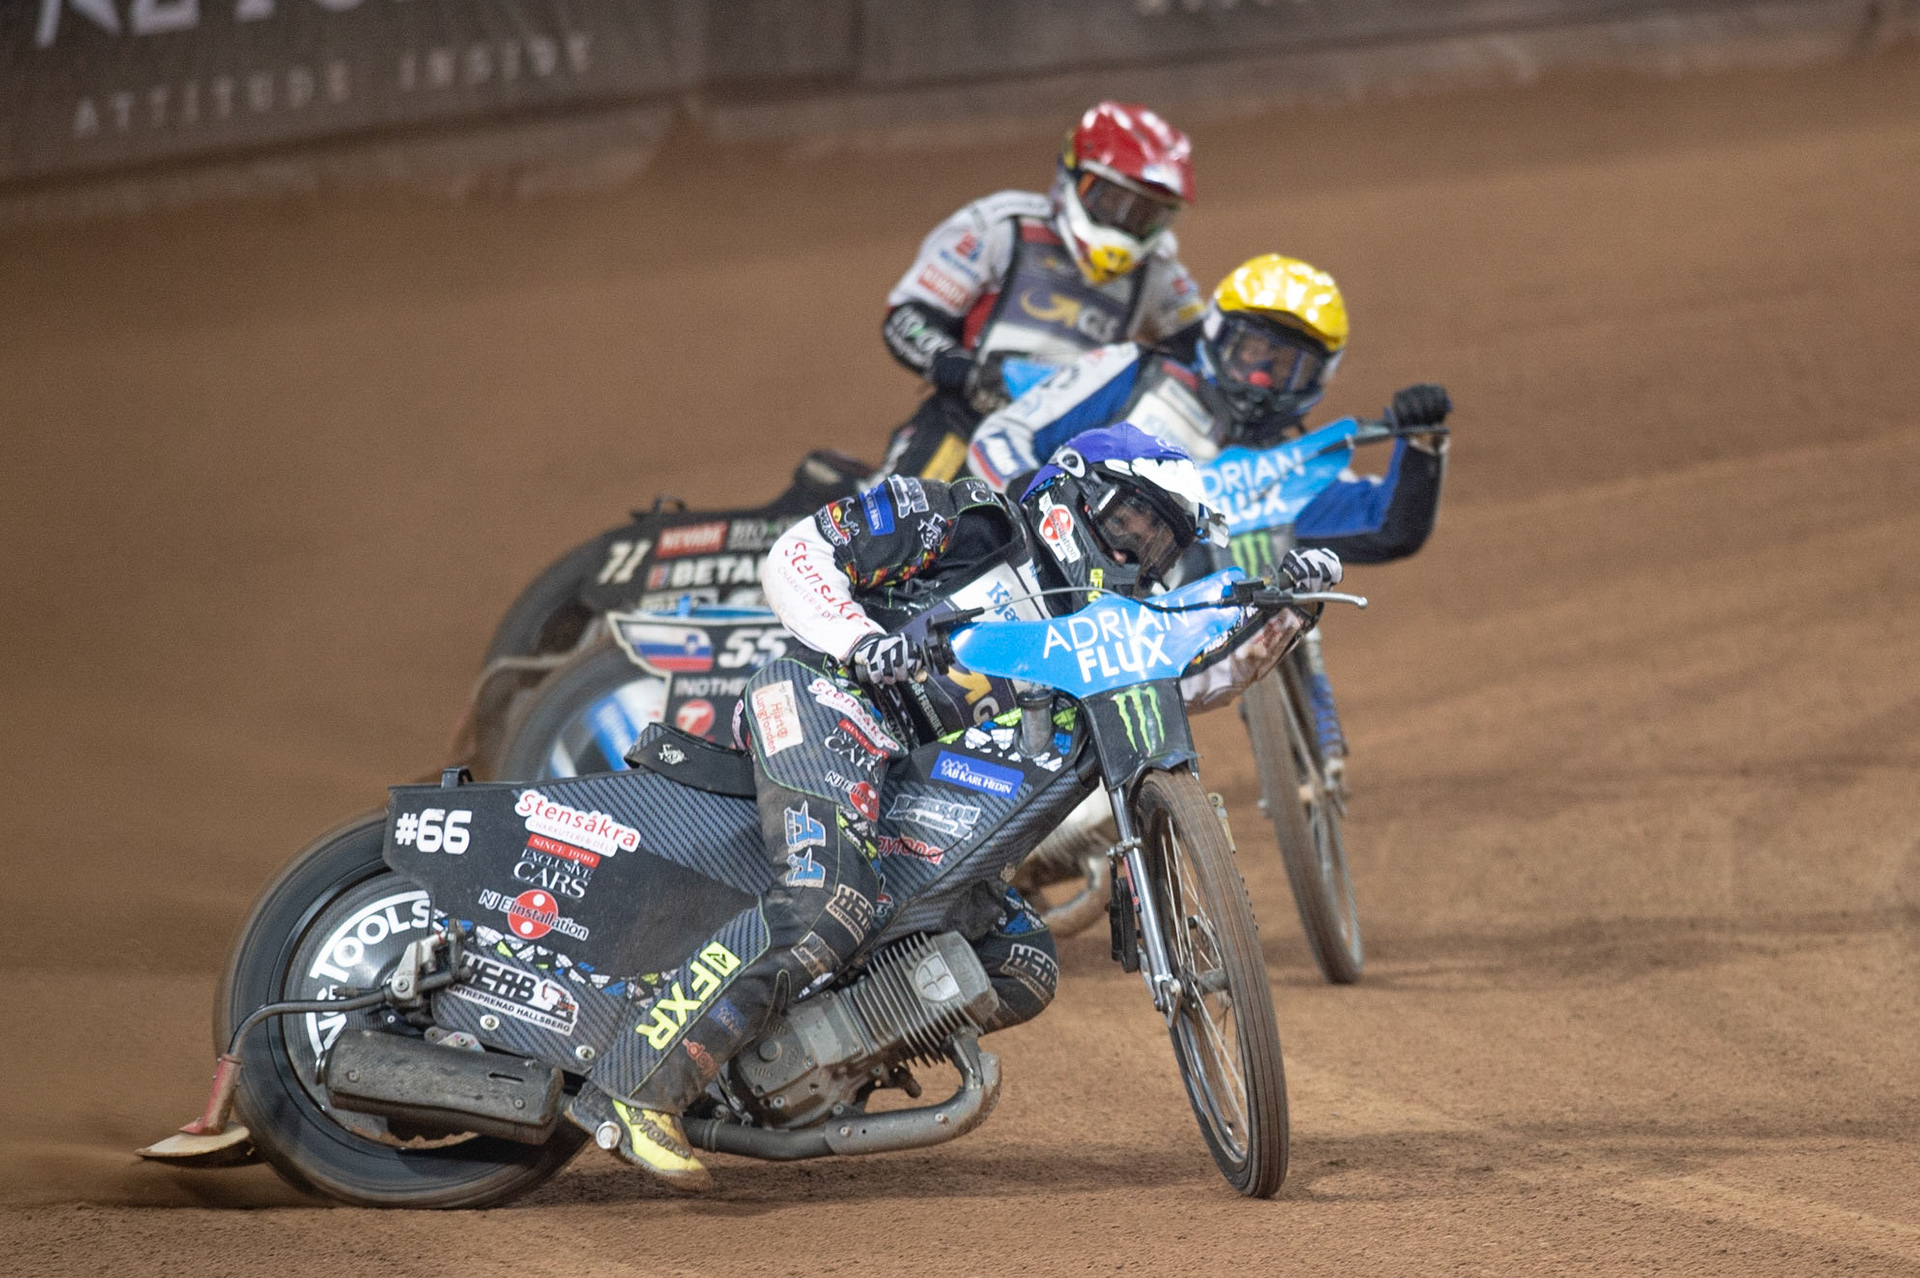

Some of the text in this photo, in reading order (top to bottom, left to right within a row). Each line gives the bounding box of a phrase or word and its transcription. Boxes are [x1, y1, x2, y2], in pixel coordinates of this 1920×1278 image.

[1200, 447, 1305, 498] DRIAN
[1219, 483, 1287, 525] LUX
[1043, 598, 1190, 659] ADRIAN
[1077, 633, 1172, 683] FLUX
[959, 771, 982, 787] KARL
[983, 780, 1013, 794] HEDIN
[395, 808, 472, 855] #66
[519, 794, 636, 847] Stensåkra
[521, 848, 592, 881] EXCLUSIVE
[533, 838, 563, 854] SINCE
[877, 834, 943, 865] aytona
[514, 861, 588, 898] CARS
[480, 890, 588, 940] NJ Elinstallation
[309, 896, 430, 983] TOOLS
[517, 1007, 570, 1033] HALLSBERG
[636, 961, 721, 1050] FXR
